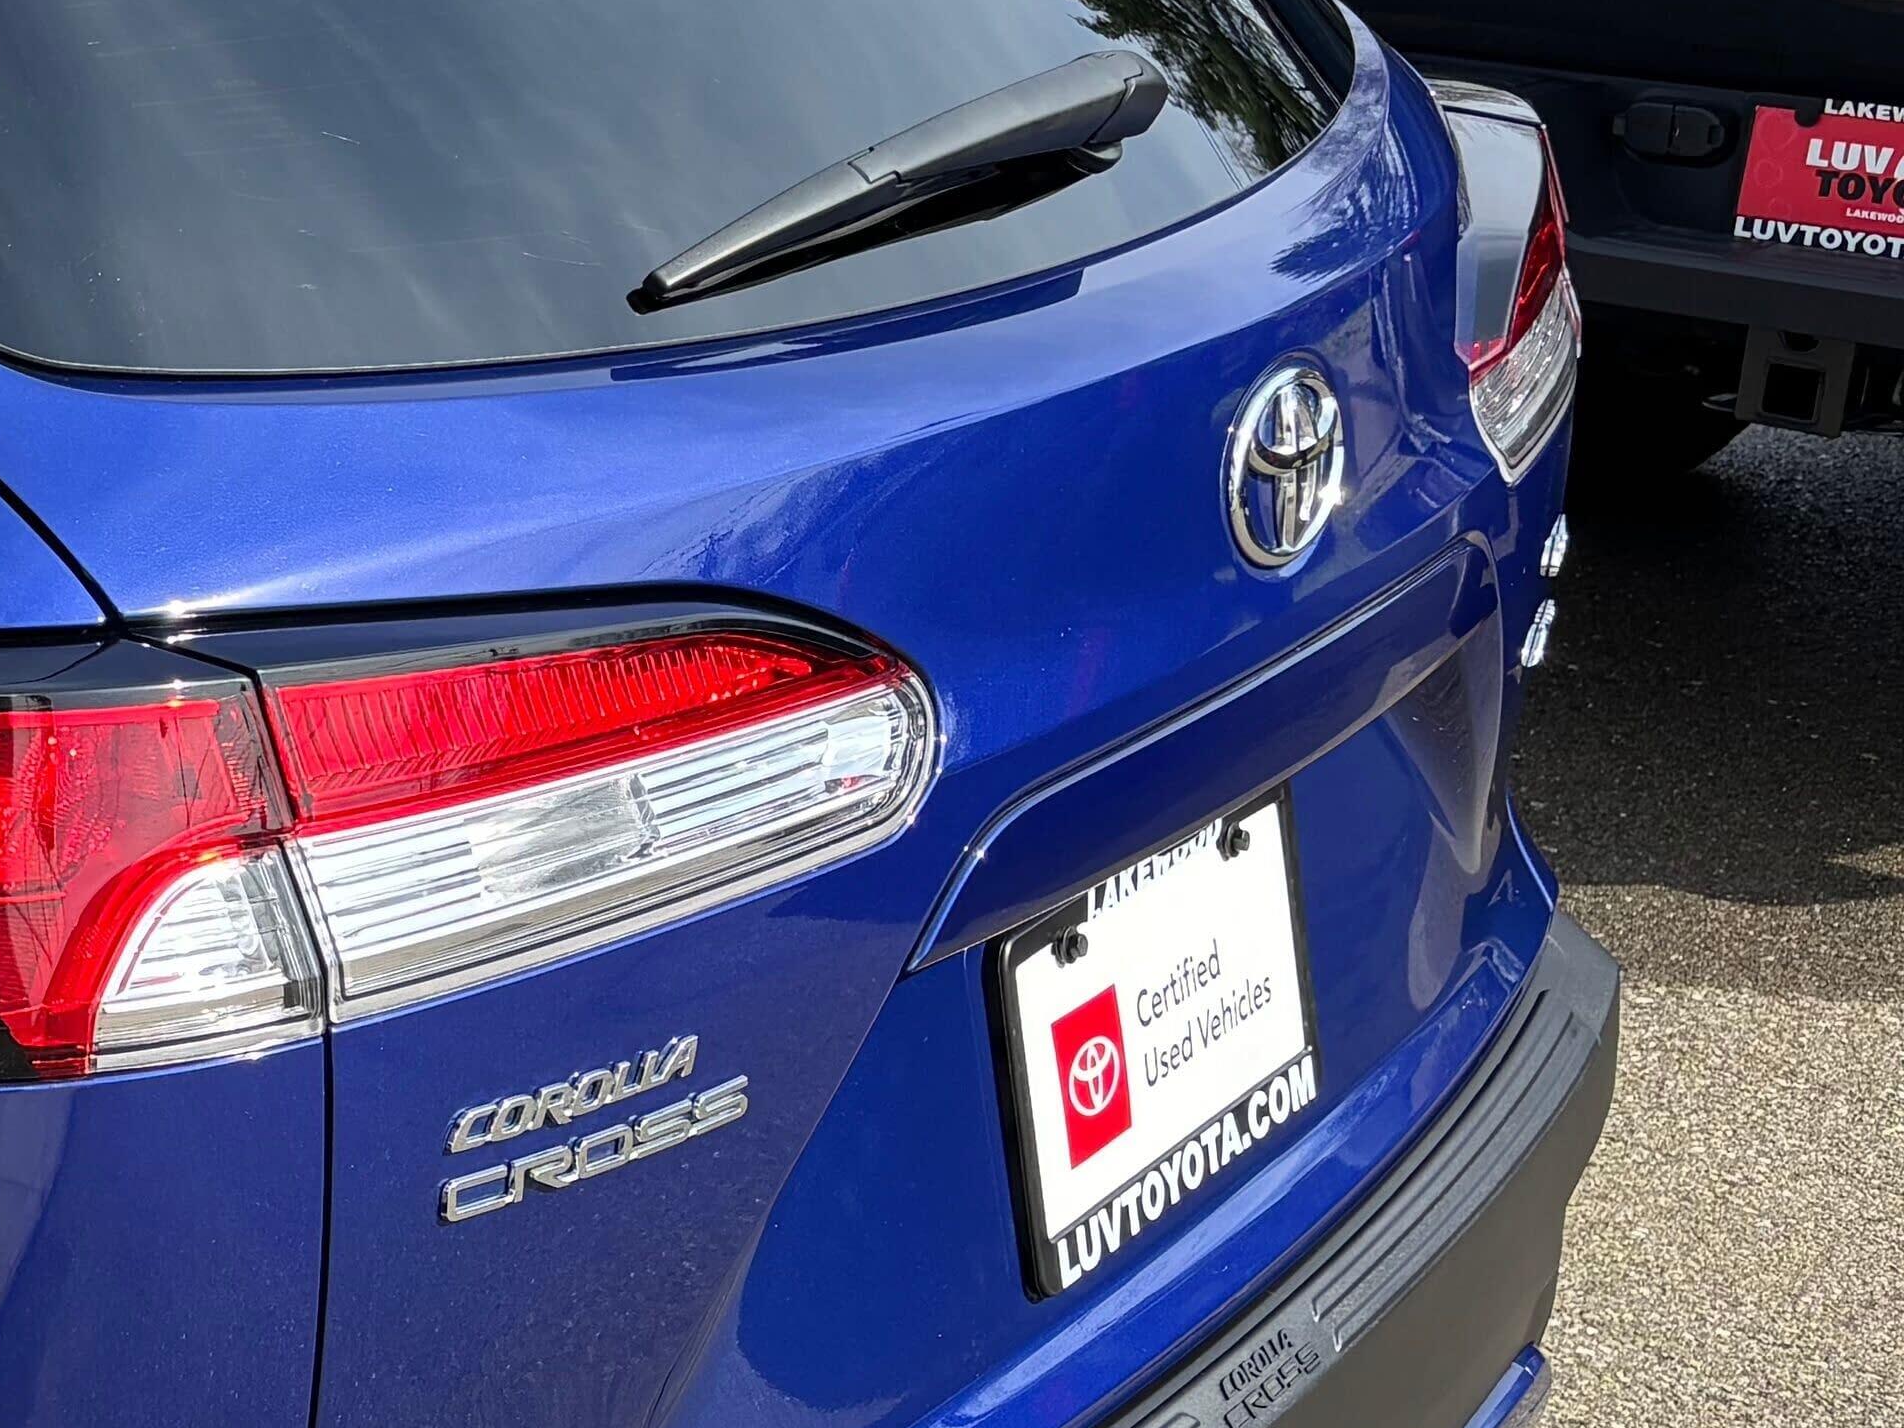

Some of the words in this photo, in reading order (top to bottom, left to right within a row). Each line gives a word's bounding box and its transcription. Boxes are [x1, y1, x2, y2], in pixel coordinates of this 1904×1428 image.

[1805, 138, 1895, 176] LUV
[1136, 938, 1222, 1027] Certified
[1143, 1021, 1193, 1087] Used
[1197, 974, 1273, 1052] Vehicles
[438, 1074, 749, 1224] CROSS
[443, 1034, 699, 1154] COROLLA
[1055, 1054, 1318, 1289] LUVTOYOTA.COM
[1218, 1327, 1295, 1402] COROLLA
